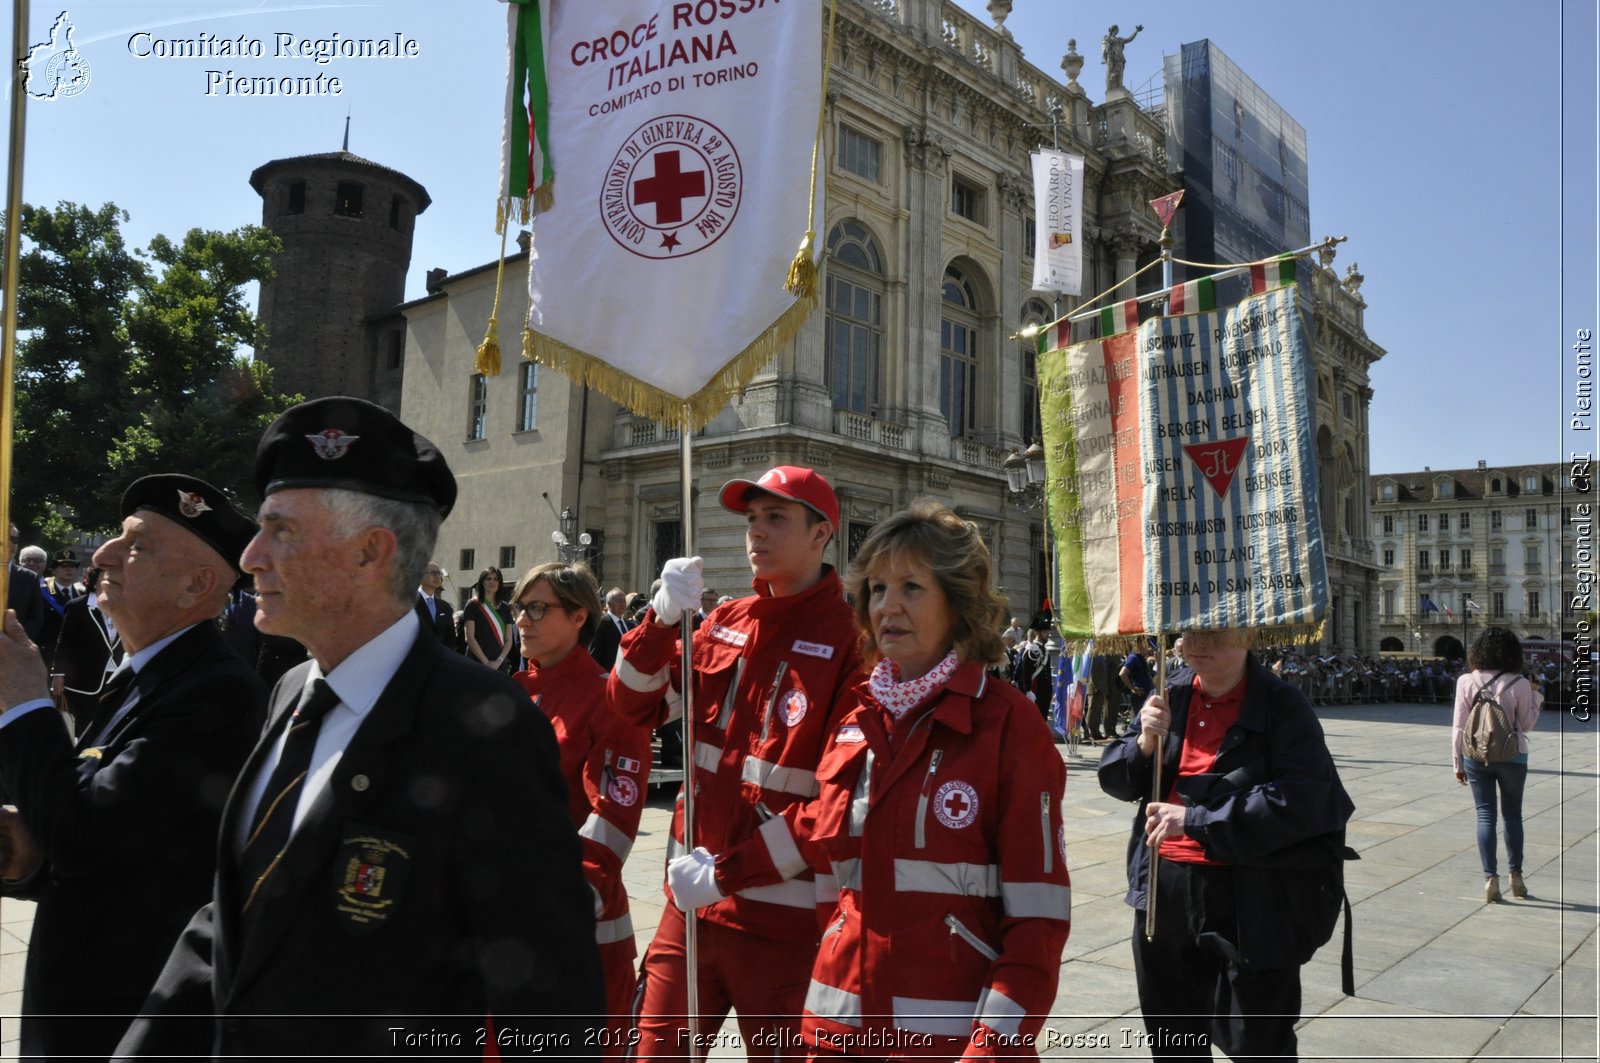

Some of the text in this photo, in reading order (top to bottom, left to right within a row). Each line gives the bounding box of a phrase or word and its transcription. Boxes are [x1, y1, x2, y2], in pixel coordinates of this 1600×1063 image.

[570, 13, 659, 66] CROCE
[607, 29, 738, 91] ITALIANA
[589, 62, 759, 117] COMITATO DI TORINO
[606, 121, 736, 245] CONVENZIONE DI GINEVRA 22 AGOSTO 1864
[1049, 156, 1060, 229] LEONARDO
[1063, 172, 1073, 232] DA VINCI
[1142, 341, 1283, 381] AUTHAUSEN BUCHENWALD
[1187, 384, 1239, 405] DACHAU
[1158, 407, 1268, 438] BERGEN BELSEN
[1257, 439, 1289, 458] DORA
[1160, 468, 1293, 502] MELK EBENSEE
[1146, 518, 1226, 538] SACHSENHAUSEN
[1194, 546, 1255, 565] BOLZANO
[1148, 572, 1304, 598] RISIERA DI SAN SABBA
